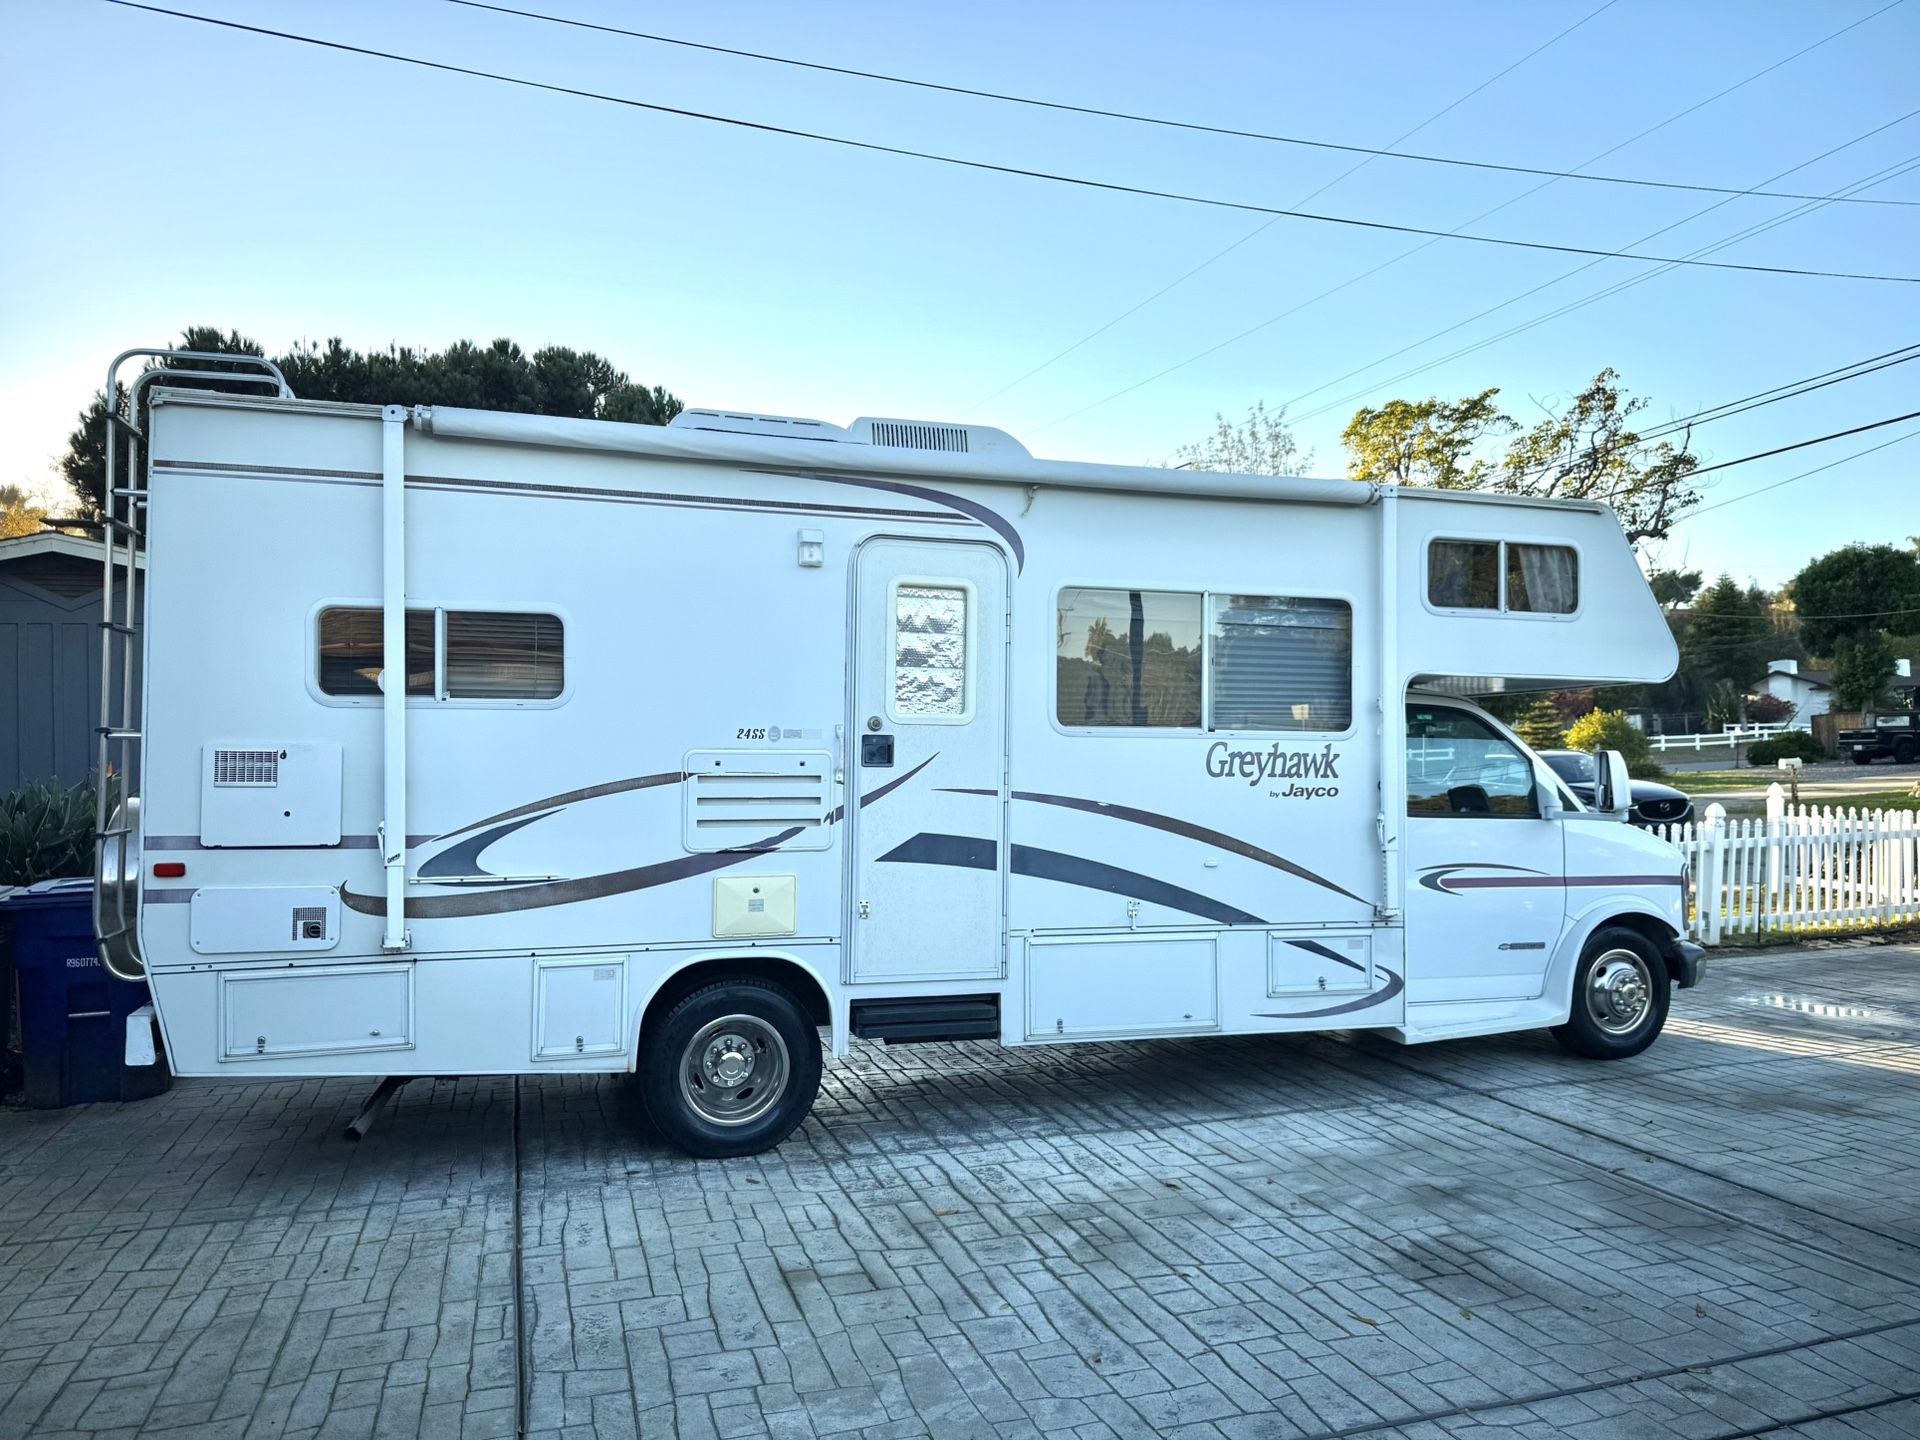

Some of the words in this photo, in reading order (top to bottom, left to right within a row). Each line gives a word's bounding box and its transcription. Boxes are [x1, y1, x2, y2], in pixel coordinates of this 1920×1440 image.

[736, 728, 766, 740] 24SS
[1205, 741, 1341, 787] Greyhawk
[1269, 790, 1281, 799] by
[1281, 783, 1339, 800] Jayco
